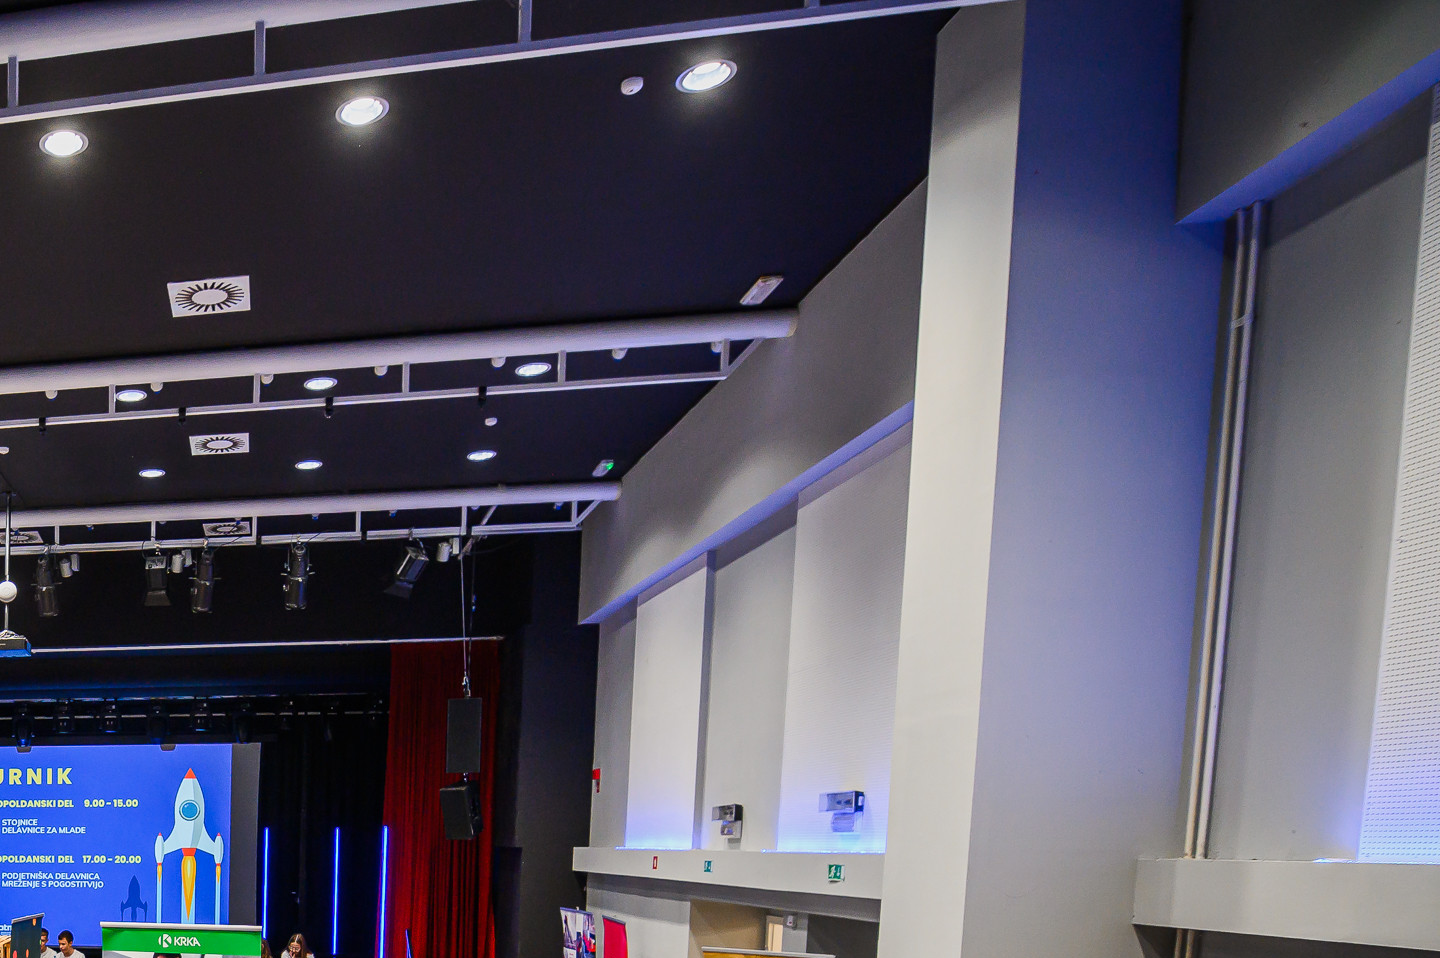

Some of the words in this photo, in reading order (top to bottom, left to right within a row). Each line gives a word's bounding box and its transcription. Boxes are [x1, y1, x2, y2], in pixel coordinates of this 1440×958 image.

[57, 799, 74, 808] DEL
[83, 799, 105, 808] 9.00
[113, 799, 139, 808] 15.00
[1, 818, 38, 828] STOJNICE
[1, 826, 46, 834] DELAVNICE
[46, 826, 58, 834] ZA
[59, 826, 86, 834] MLADE
[58, 855, 74, 864] DEL
[82, 855, 106, 864] 17.00
[114, 855, 142, 864] 20.00
[1, 870, 54, 881] PODJETNIŠKA
[55, 872, 100, 880] DELAVNICA
[41, 880, 47, 888] S
[173, 936, 202, 947] KRKA
